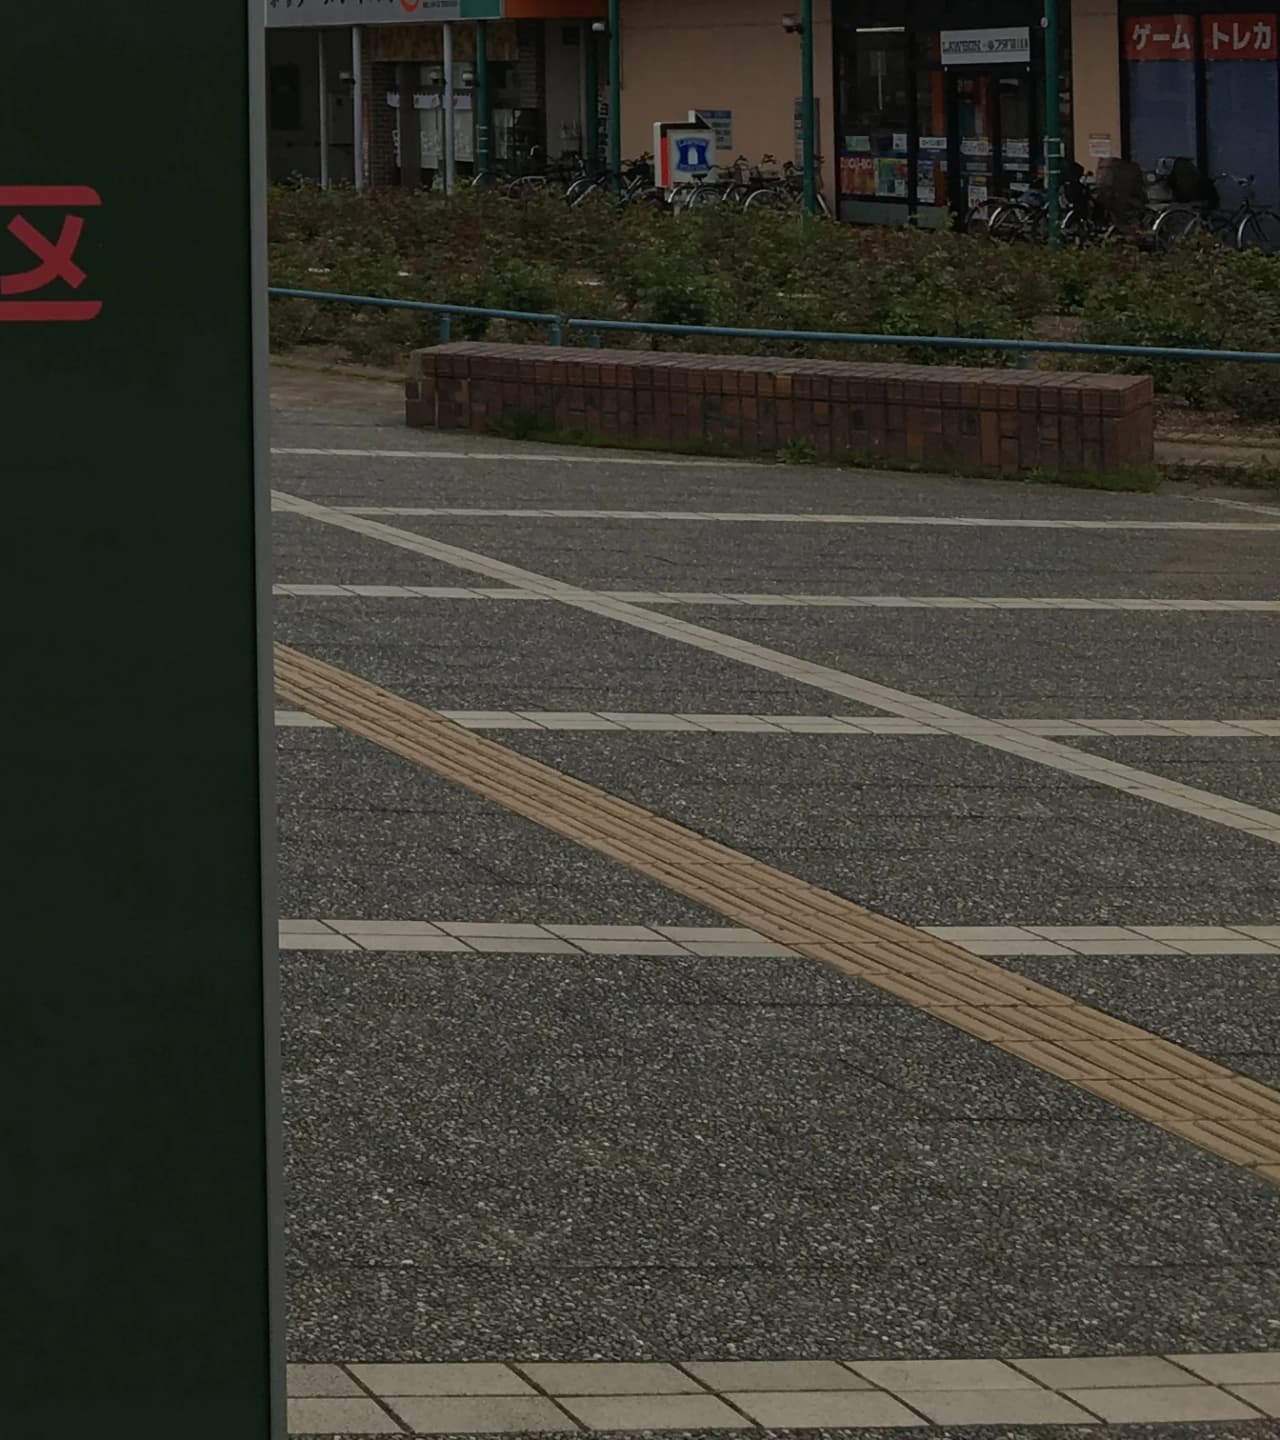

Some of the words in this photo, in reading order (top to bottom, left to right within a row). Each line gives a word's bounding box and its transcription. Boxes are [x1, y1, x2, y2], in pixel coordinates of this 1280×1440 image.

[1132, 23, 1191, 51] ゲーム
[1212, 21, 1272, 50] トレカ
